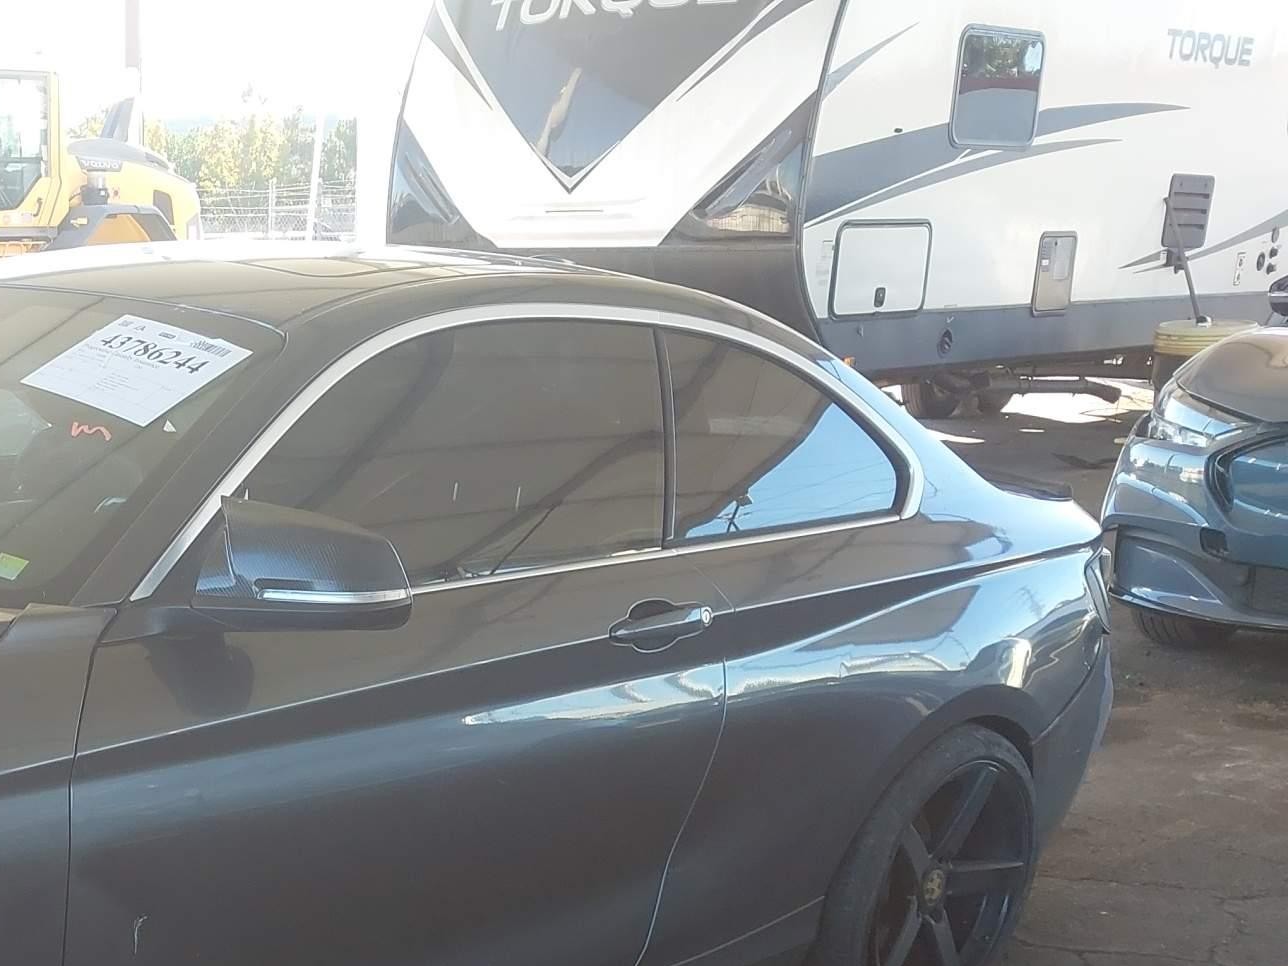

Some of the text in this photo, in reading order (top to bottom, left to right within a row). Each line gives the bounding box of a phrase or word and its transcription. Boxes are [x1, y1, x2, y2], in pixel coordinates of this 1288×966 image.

[1167, 28, 1255, 69] TORQUE
[79, 159, 120, 169] VOLVO
[101, 333, 210, 374] 43786244
